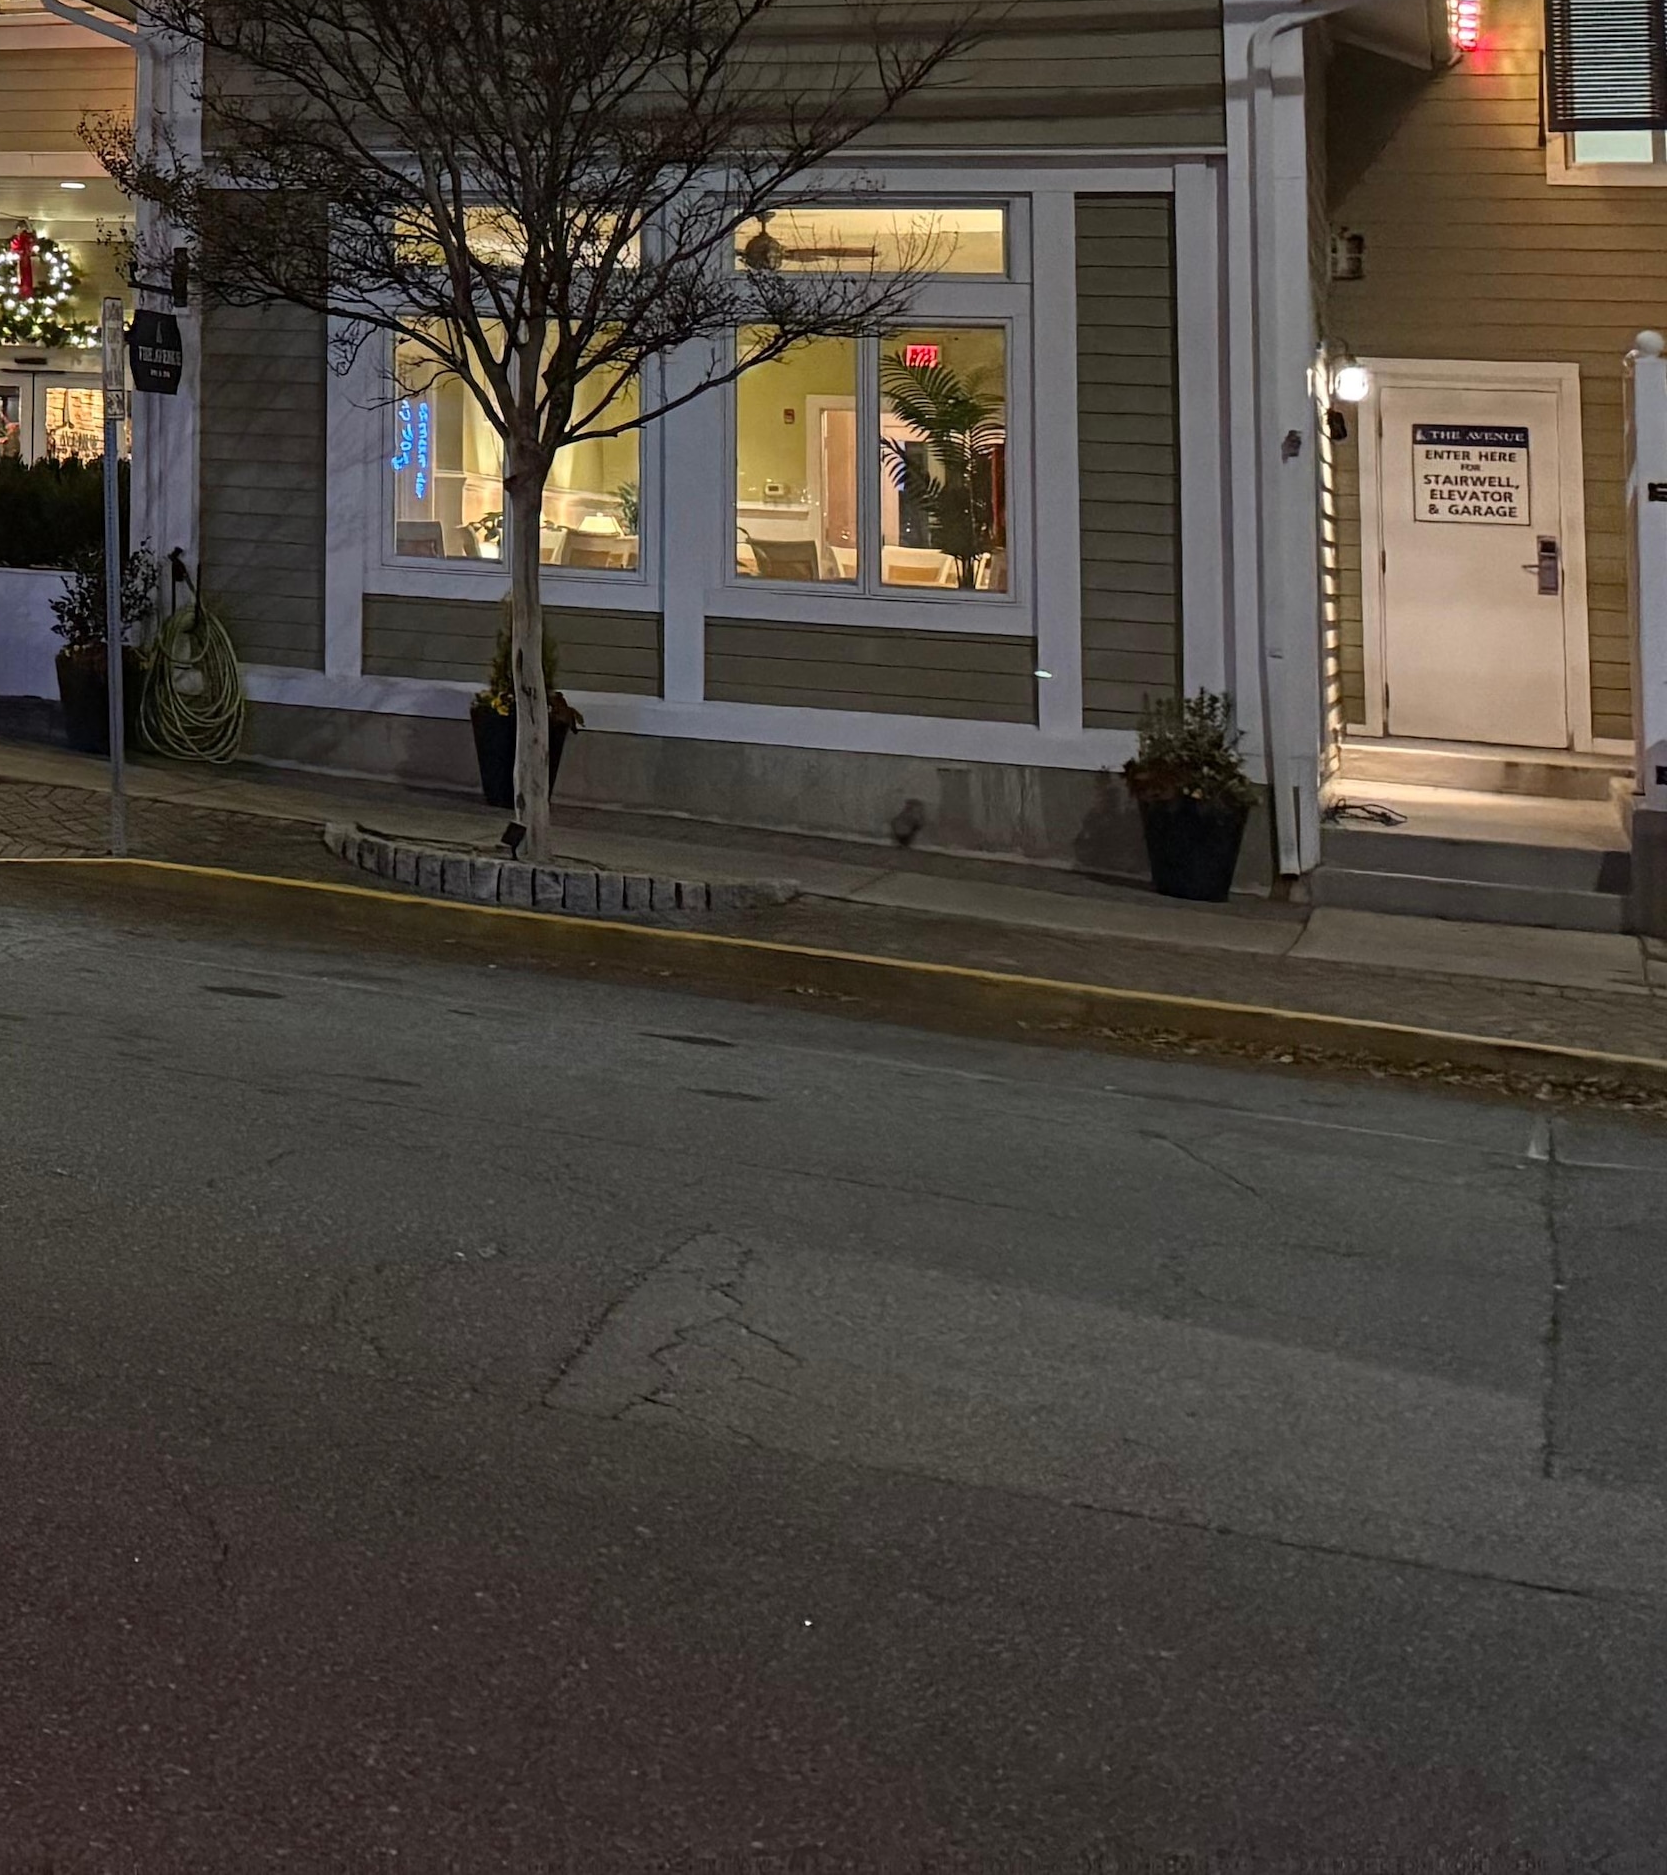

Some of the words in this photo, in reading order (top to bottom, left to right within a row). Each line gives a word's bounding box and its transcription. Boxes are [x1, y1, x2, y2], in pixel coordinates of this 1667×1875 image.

[1430, 430, 1461, 441] THE
[1466, 431, 1526, 443] AVENUE
[1425, 449, 1471, 461] ENTER
[1478, 451, 1518, 463] HERE
[1460, 463, 1482, 472] FOR
[1423, 474, 1520, 490] STAIRWELL,
[1429, 488, 1514, 503] ELEVATOR
[1428, 503, 1439, 515] &
[1448, 504, 1519, 518] GARAGE
